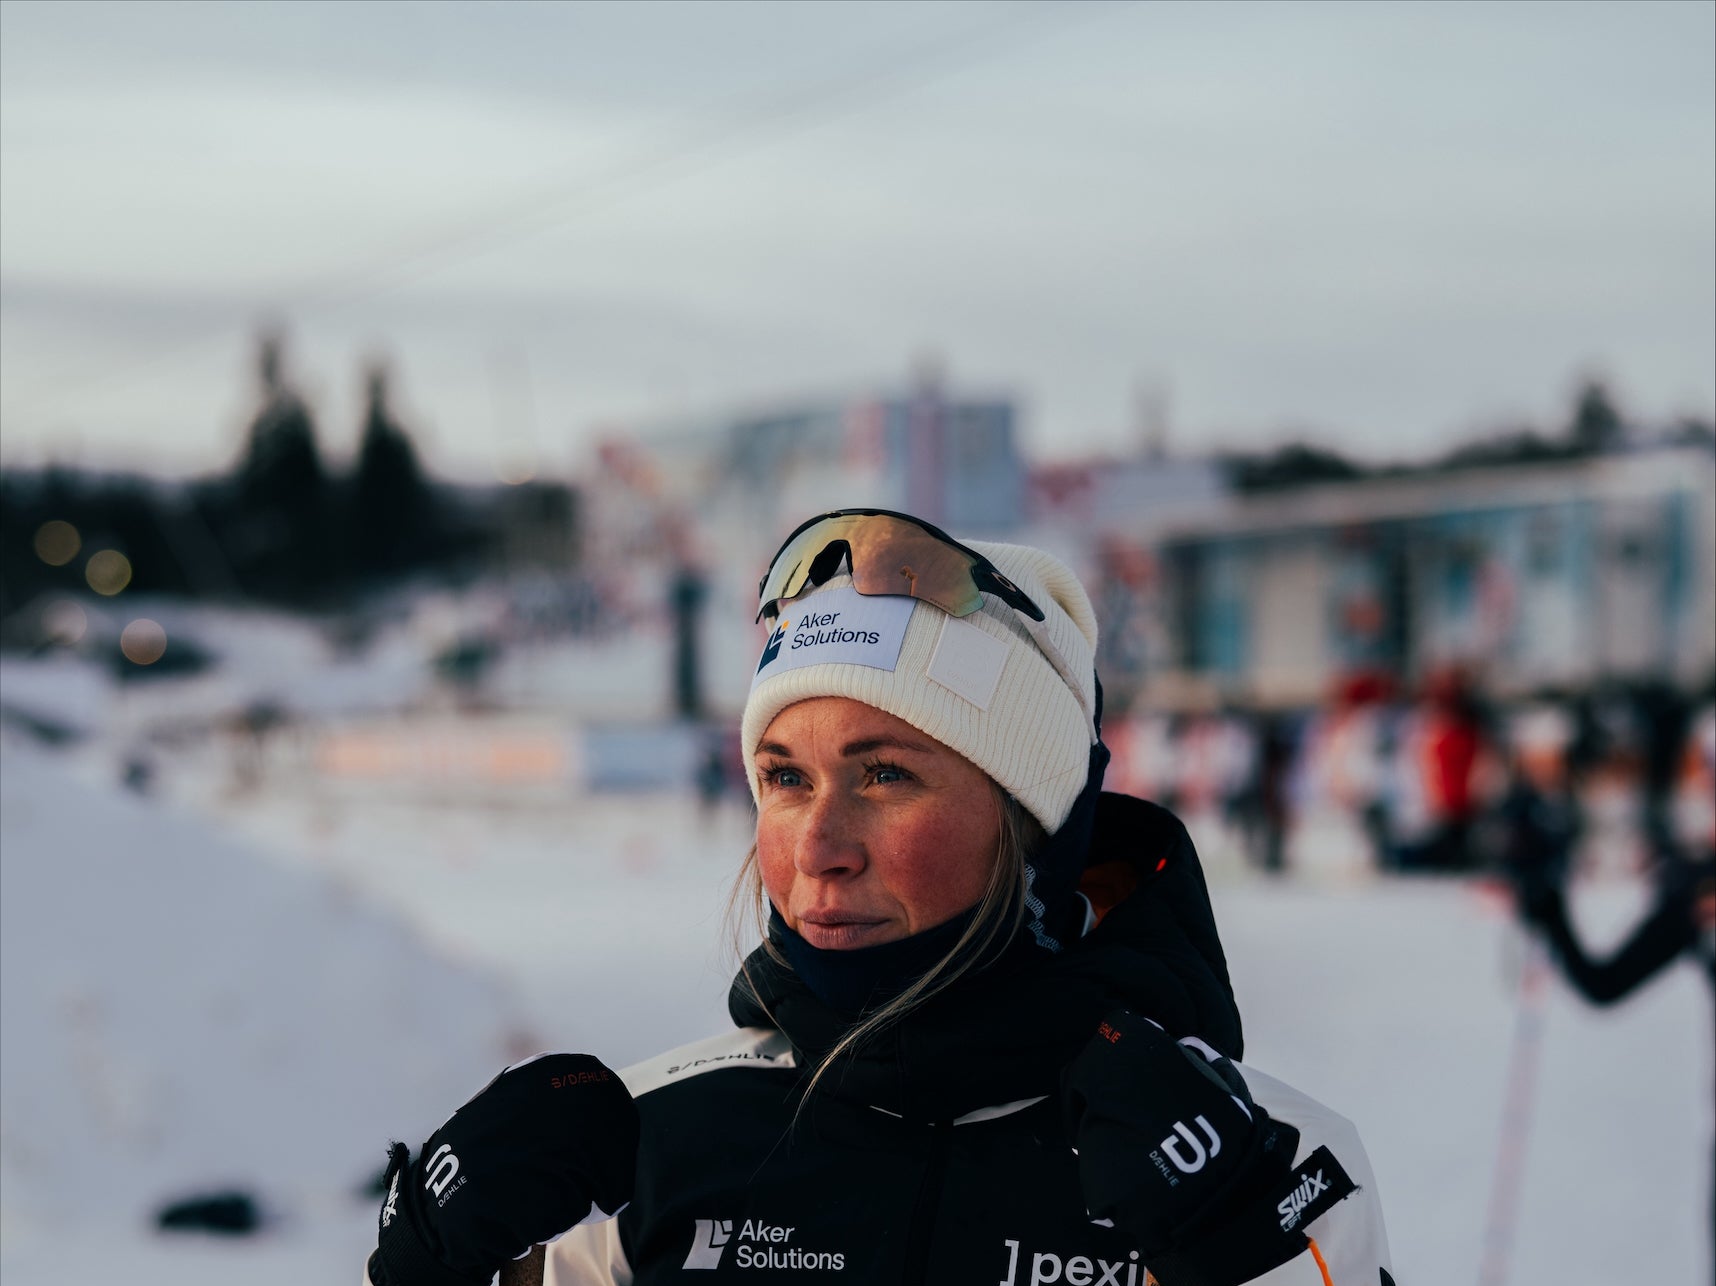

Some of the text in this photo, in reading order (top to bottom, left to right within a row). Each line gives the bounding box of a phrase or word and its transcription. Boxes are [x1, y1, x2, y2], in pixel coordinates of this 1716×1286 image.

[796, 612, 840, 632] Aker
[791, 627, 880, 650] Solutions
[738, 1218, 795, 1242] Aker
[736, 1245, 845, 1271] Solutions
